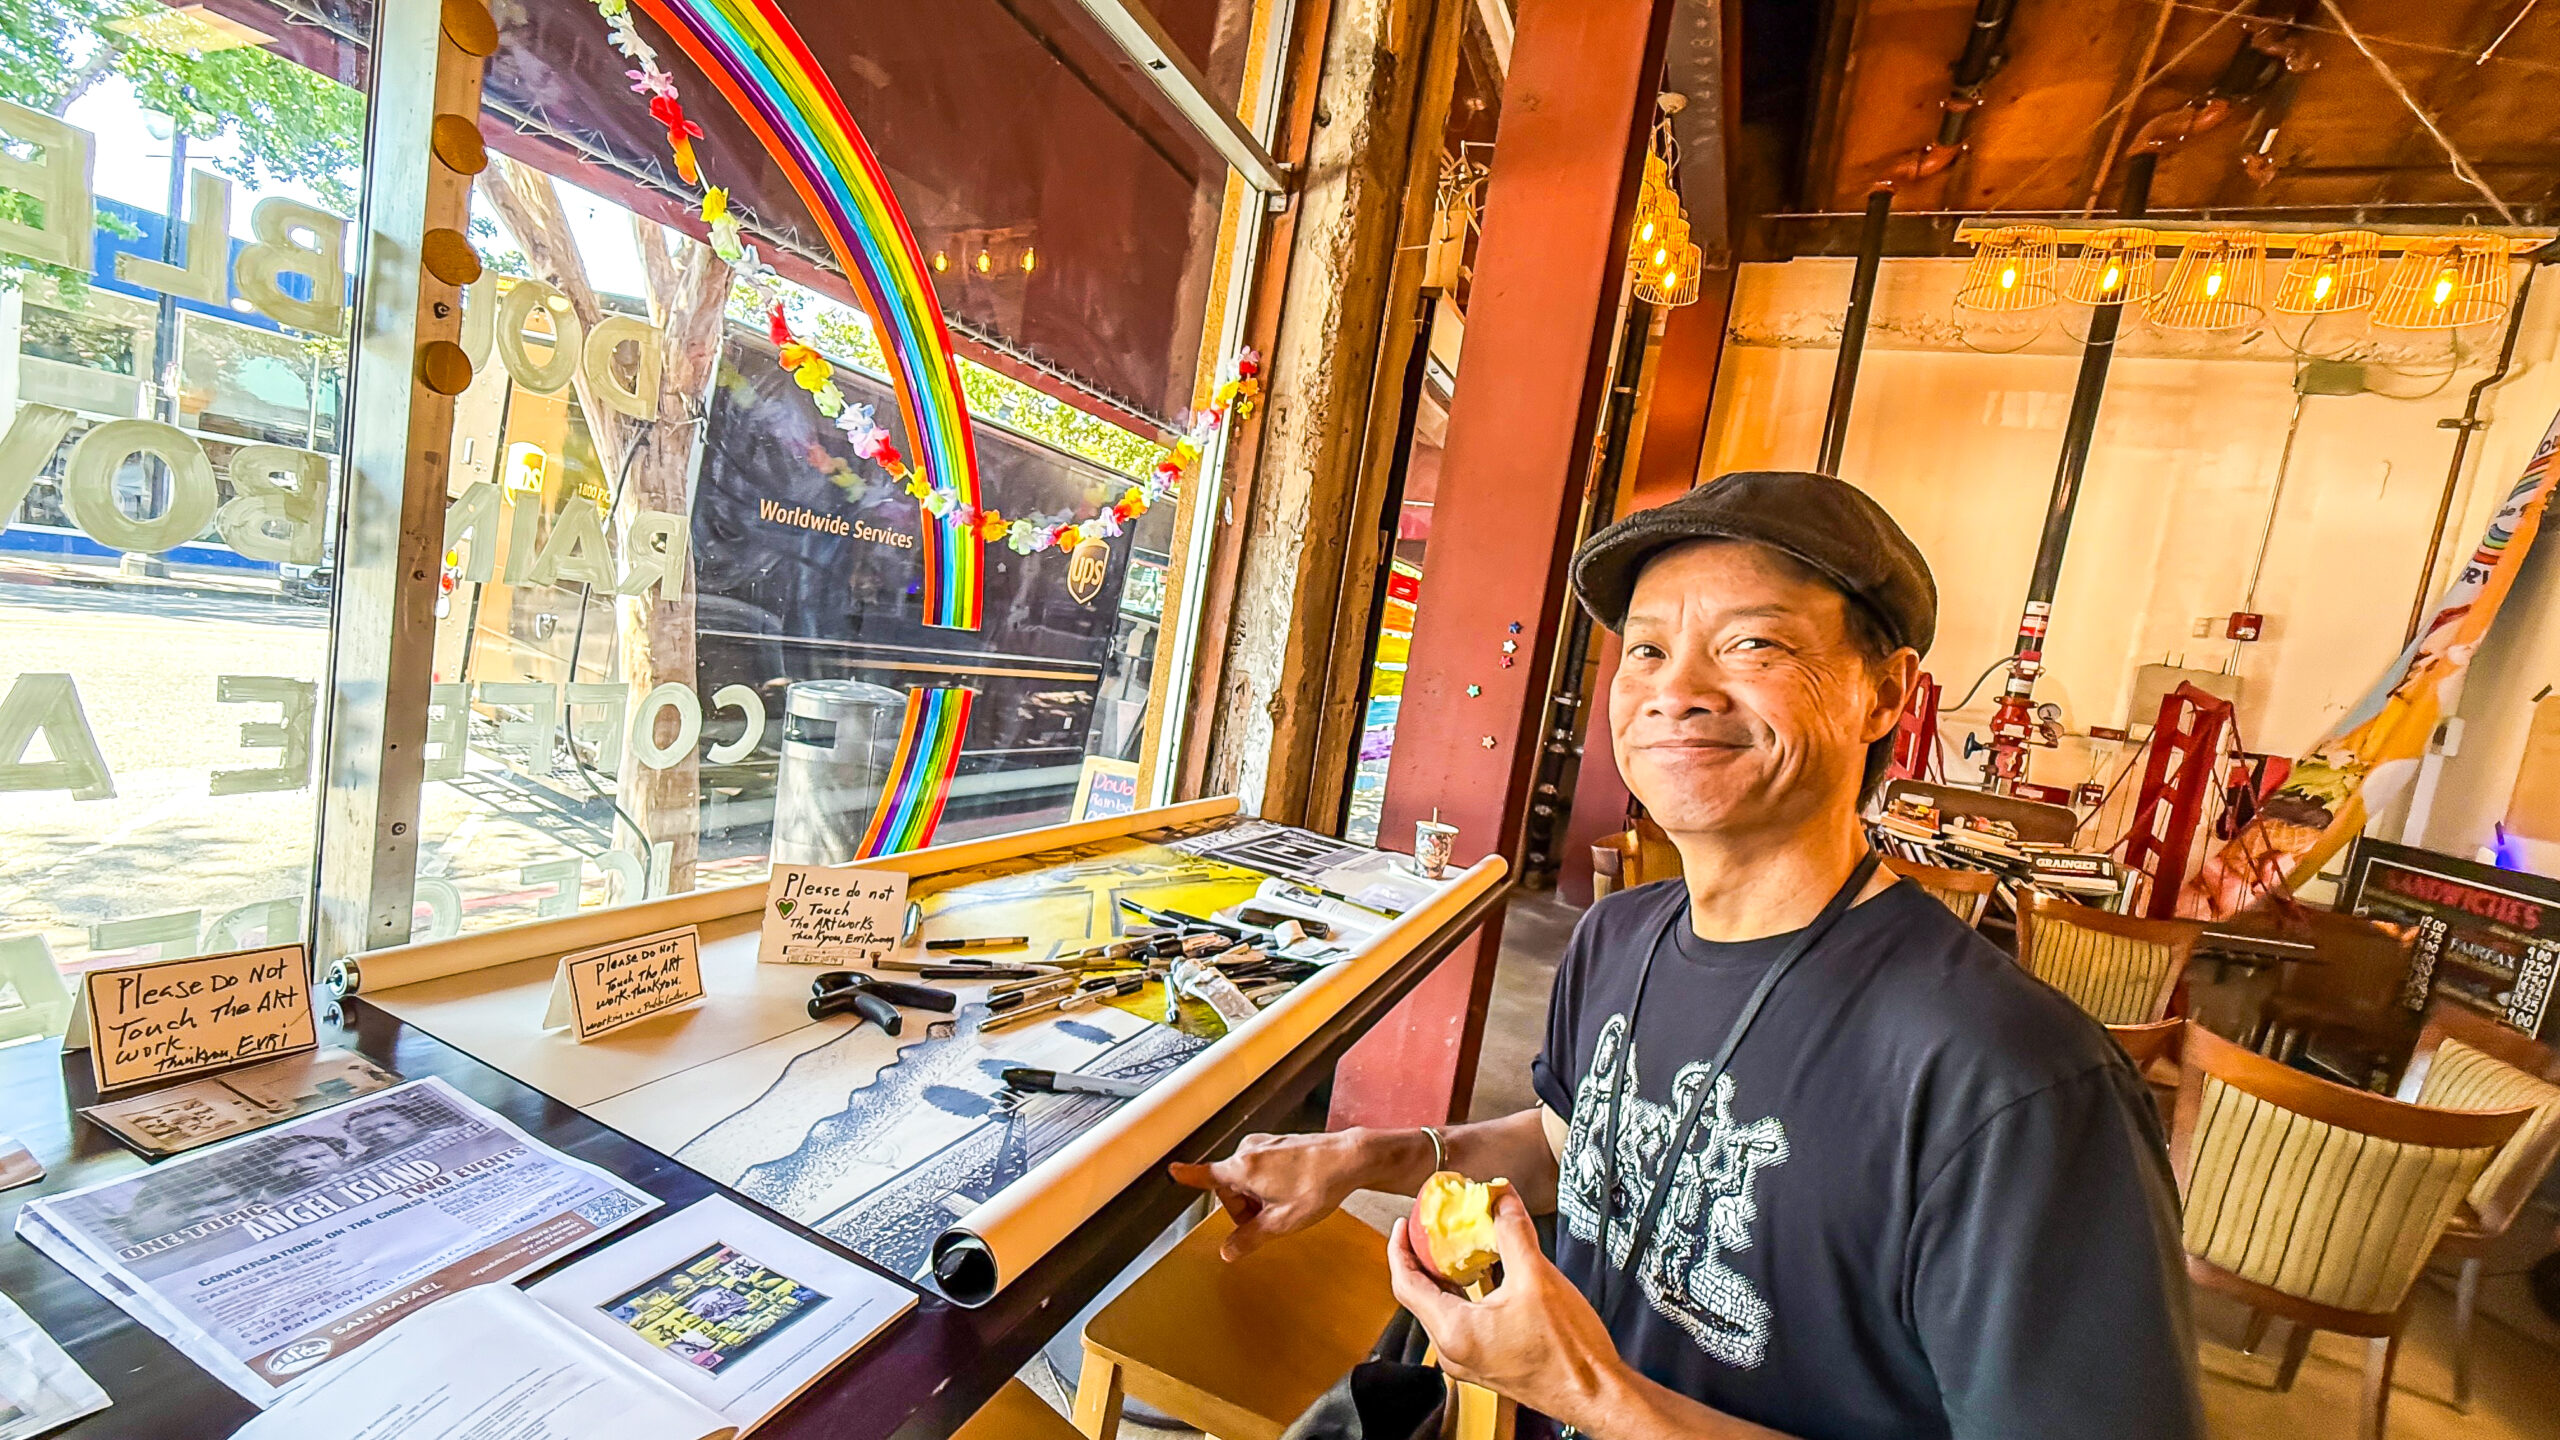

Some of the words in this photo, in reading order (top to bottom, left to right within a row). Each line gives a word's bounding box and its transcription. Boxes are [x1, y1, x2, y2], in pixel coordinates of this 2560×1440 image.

[759, 499, 850, 537] Worldwide
[852, 520, 914, 549] Services
[784, 873, 840, 897] Please
[847, 880, 861, 897] do
[868, 886, 894, 901] not
[2036, 858, 2098, 871] GRAINGER
[790, 916, 809, 929] The
[809, 901, 850, 916] Touch
[118, 974, 203, 1014] Please
[210, 975, 238, 992] Do
[249, 958, 288, 984] Not
[596, 954, 638, 986] Please
[642, 950, 655, 959] Do
[660, 941, 679, 953] Not
[606, 971, 633, 994] Touch
[638, 965, 657, 981] The
[110, 1008, 198, 1047] Touch
[211, 996, 250, 1022] The
[399, 1176, 451, 1200] TWO
[457, 1148, 529, 1179] EVENTS
[241, 1191, 347, 1242] ANGEL
[342, 1158, 442, 1205] ISLAND
[118, 1233, 184, 1261] ONE
[184, 1204, 271, 1240] TOPIC
[198, 1237, 323, 1287] CONVERSATIONS
[325, 1227, 347, 1239] ON
[350, 1217, 375, 1230] THE
[375, 1196, 428, 1221] CHINESE
[427, 1171, 496, 1198] EXCLUSION
[331, 1313, 374, 1336] SAN
[376, 1282, 444, 1315] RAFAEL
